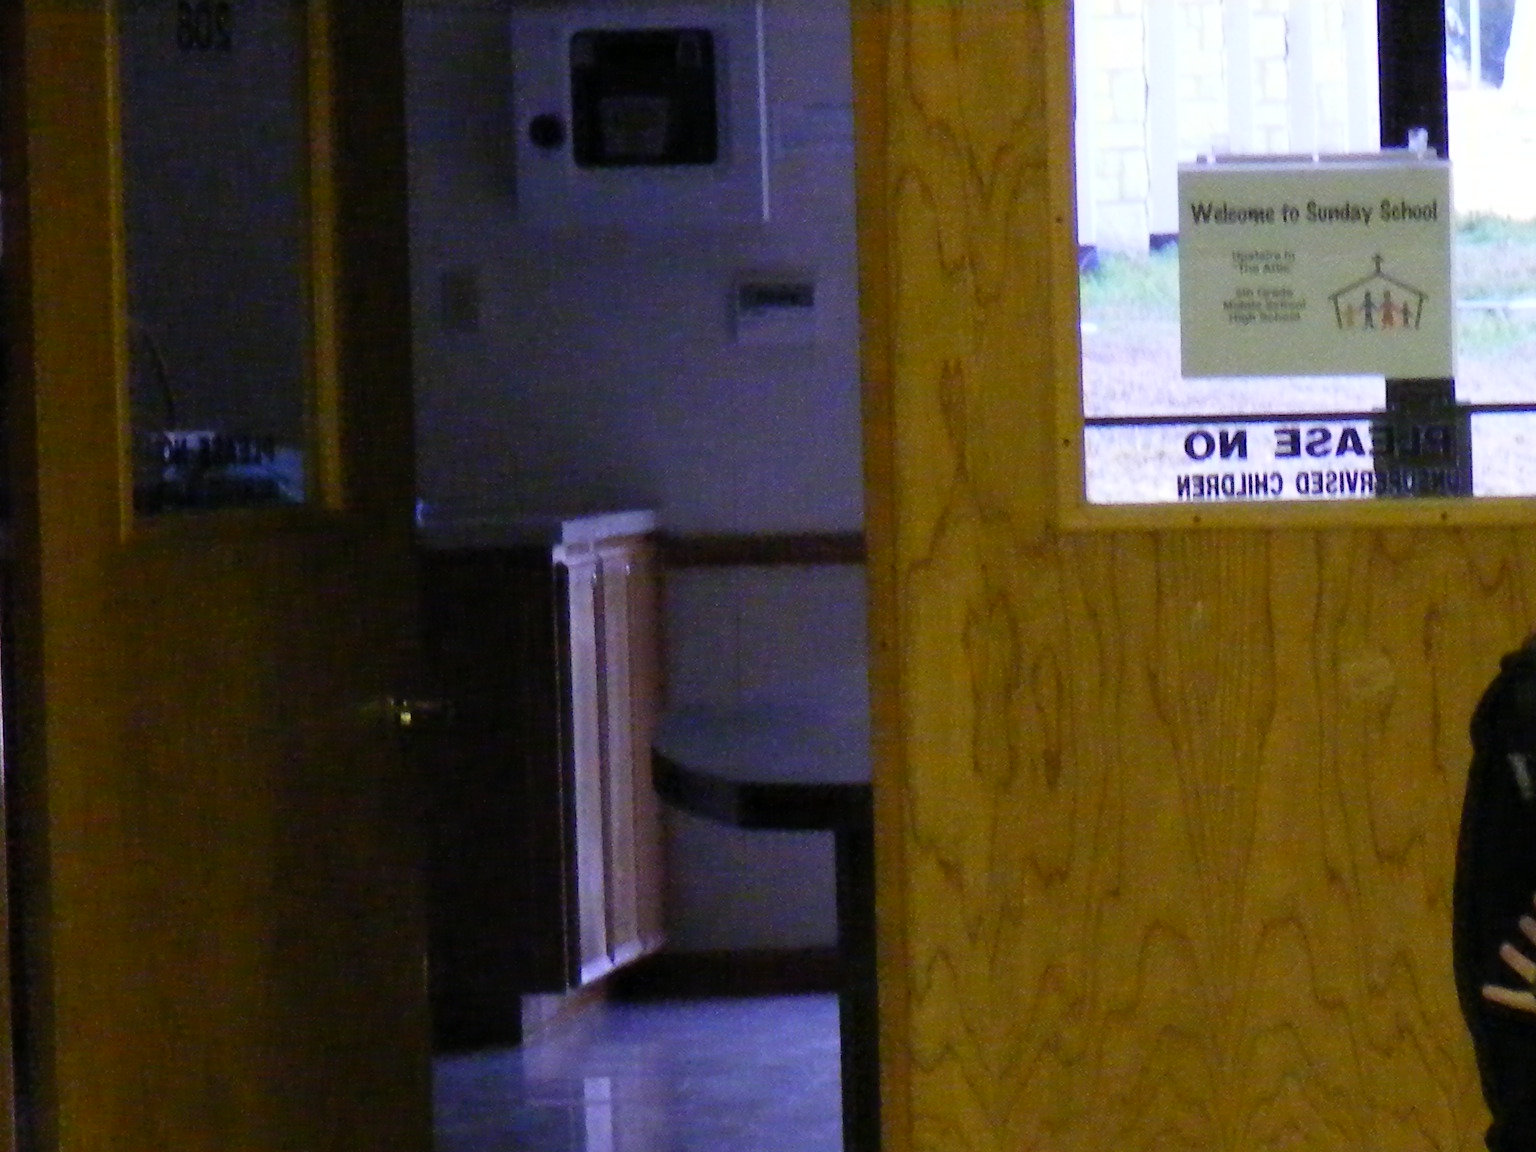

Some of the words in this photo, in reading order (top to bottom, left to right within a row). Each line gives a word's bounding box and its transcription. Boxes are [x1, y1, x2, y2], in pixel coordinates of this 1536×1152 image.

[1191, 200, 1275, 224] Welcome
[1282, 203, 1300, 223] to
[1306, 199, 1373, 226] Sunday
[1380, 199, 1438, 222] School
